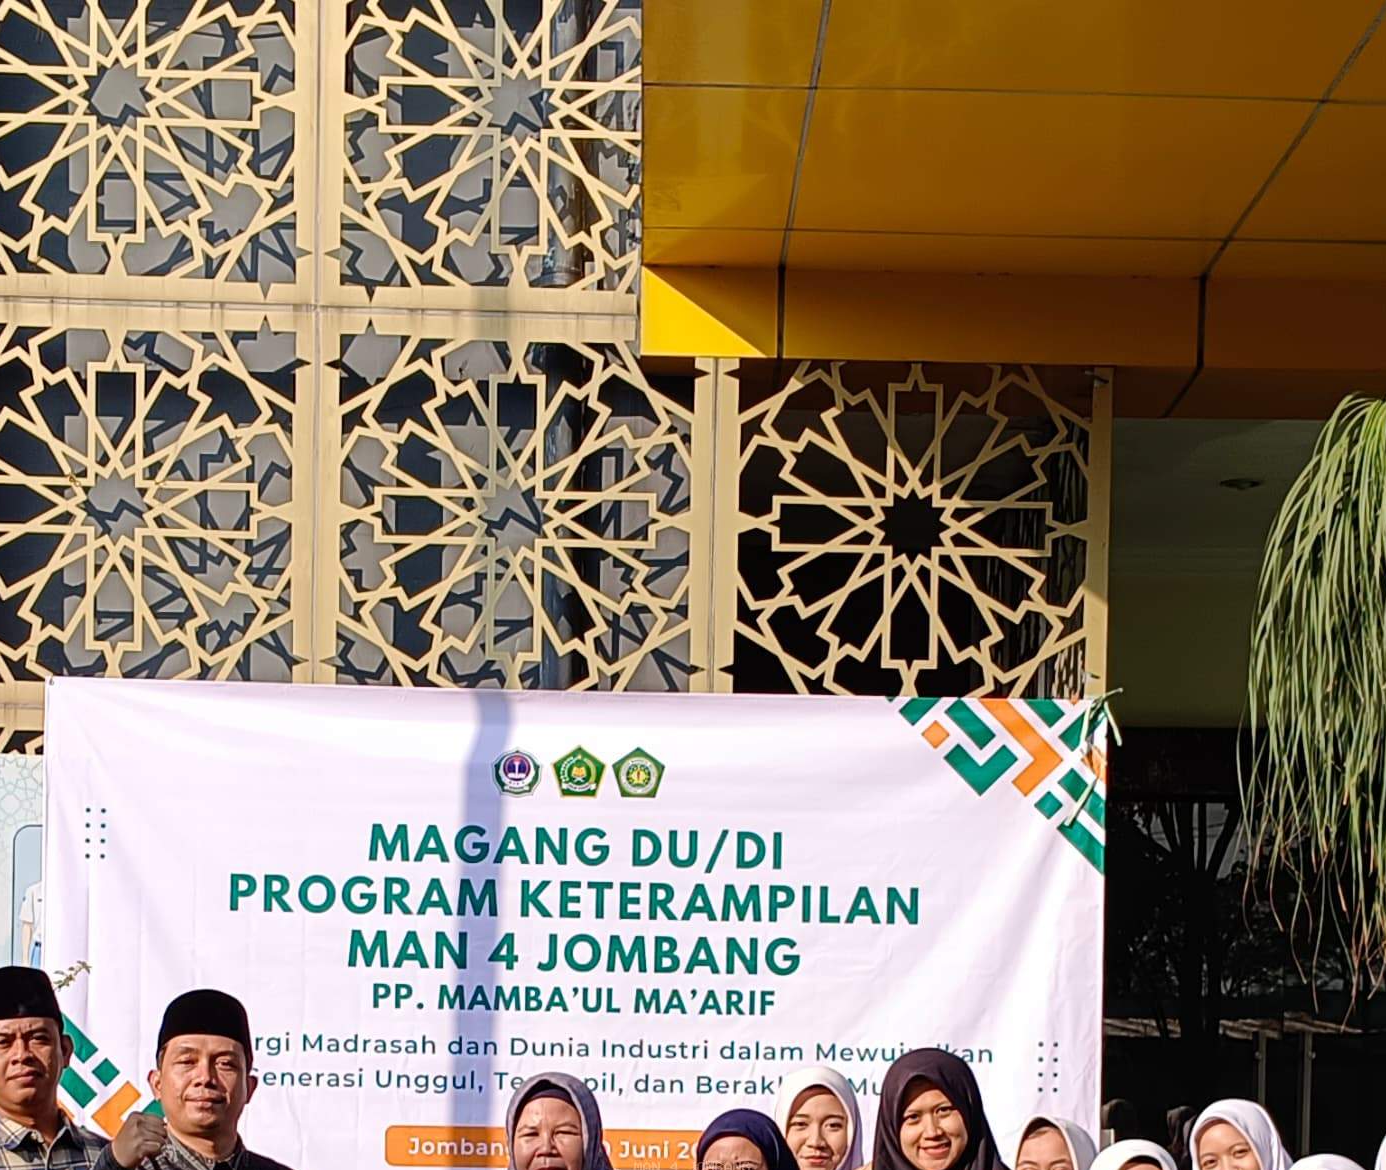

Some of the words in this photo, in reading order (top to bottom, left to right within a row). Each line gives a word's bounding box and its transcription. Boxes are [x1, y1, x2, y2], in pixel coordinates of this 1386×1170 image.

[368, 823, 611, 867] MAGANG
[631, 829, 782, 874] DU/DI
[229, 873, 499, 918] PROGRAM
[519, 879, 920, 925] KETERAMPILAN
[347, 929, 469, 970] MAN
[487, 932, 519, 971] 4
[537, 933, 801, 976] JOMBANG
[372, 983, 425, 1010] PP.
[301, 1033, 436, 1055] Madrasah
[447, 1035, 498, 1056] dan
[509, 1036, 590, 1058] Dunia
[601, 1039, 709, 1060] Industri
[719, 1041, 804, 1062] dalam
[374, 1070, 484, 1094] Unggul,
[493, 1071, 623, 1097] Tepil,
[633, 1074, 685, 1094] dan
[408, 1137, 510, 1160] Jomban
[618, 1139, 669, 1160] Juni
